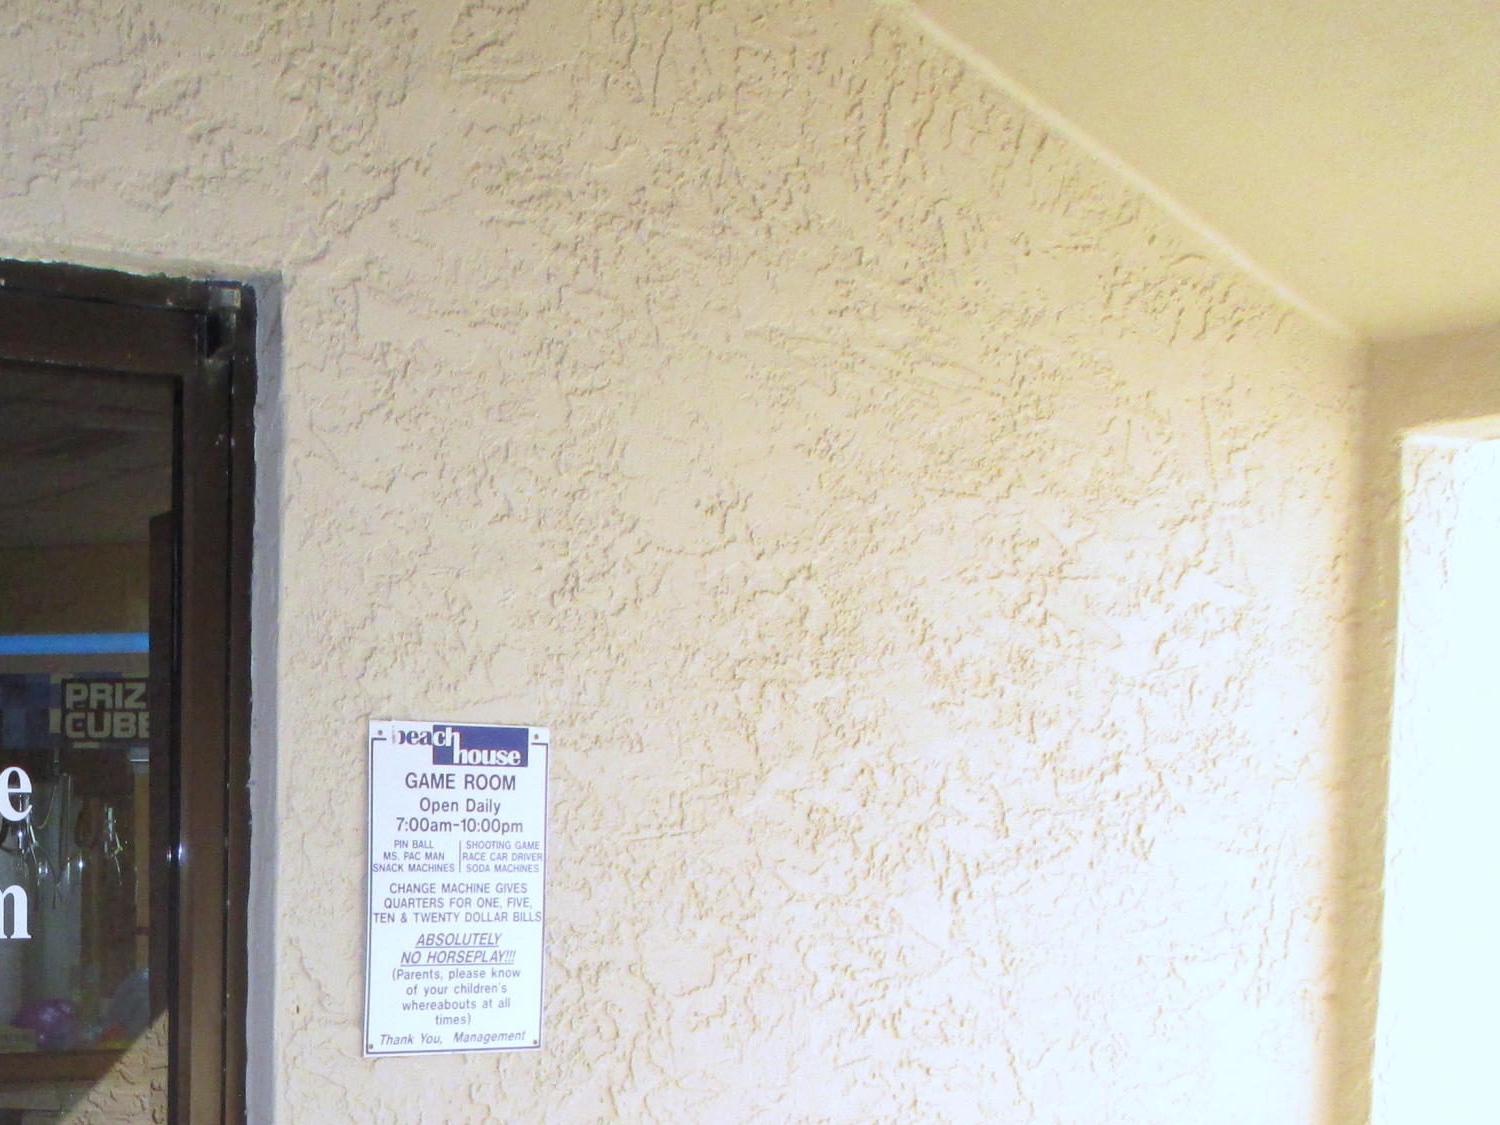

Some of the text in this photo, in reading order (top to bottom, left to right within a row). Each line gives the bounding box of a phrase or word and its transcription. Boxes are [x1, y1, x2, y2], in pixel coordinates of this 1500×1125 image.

[453, 747, 521, 765] house
[405, 772, 516, 790] GAME ROOM
[420, 797, 501, 815] Open Daily
[396, 817, 523, 835] 7:00am-10:00pm
[394, 840, 434, 849] PIN BALL
[466, 840, 541, 850] SHOOTING GAME
[404, 852, 422, 861] PAC
[425, 852, 445, 861] MAN
[462, 853, 543, 862] RACE CAR DRIVER
[372, 864, 455, 873] SNACK MACHINES
[466, 864, 540, 873] SODA MACHINES
[389, 883, 528, 894] CHANGE MACHINE GIVES
[384, 897, 444, 909] QUARTERS
[449, 897, 472, 908] FOR
[373, 911, 542, 923] TEN & TWENTY DOLLAR BILLS
[416, 933, 502, 946] ABSOLUTELY
[401, 950, 517, 964] NO HORSEPLAY!!!
[392, 967, 521, 984] (Parents, please know
[406, 982, 508, 997] of your children's
[402, 998, 511, 1011] whereabouts at all
[435, 1013, 472, 1026] times)
[380, 1034, 414, 1045] Thank
[453, 1031, 526, 1044] Management
